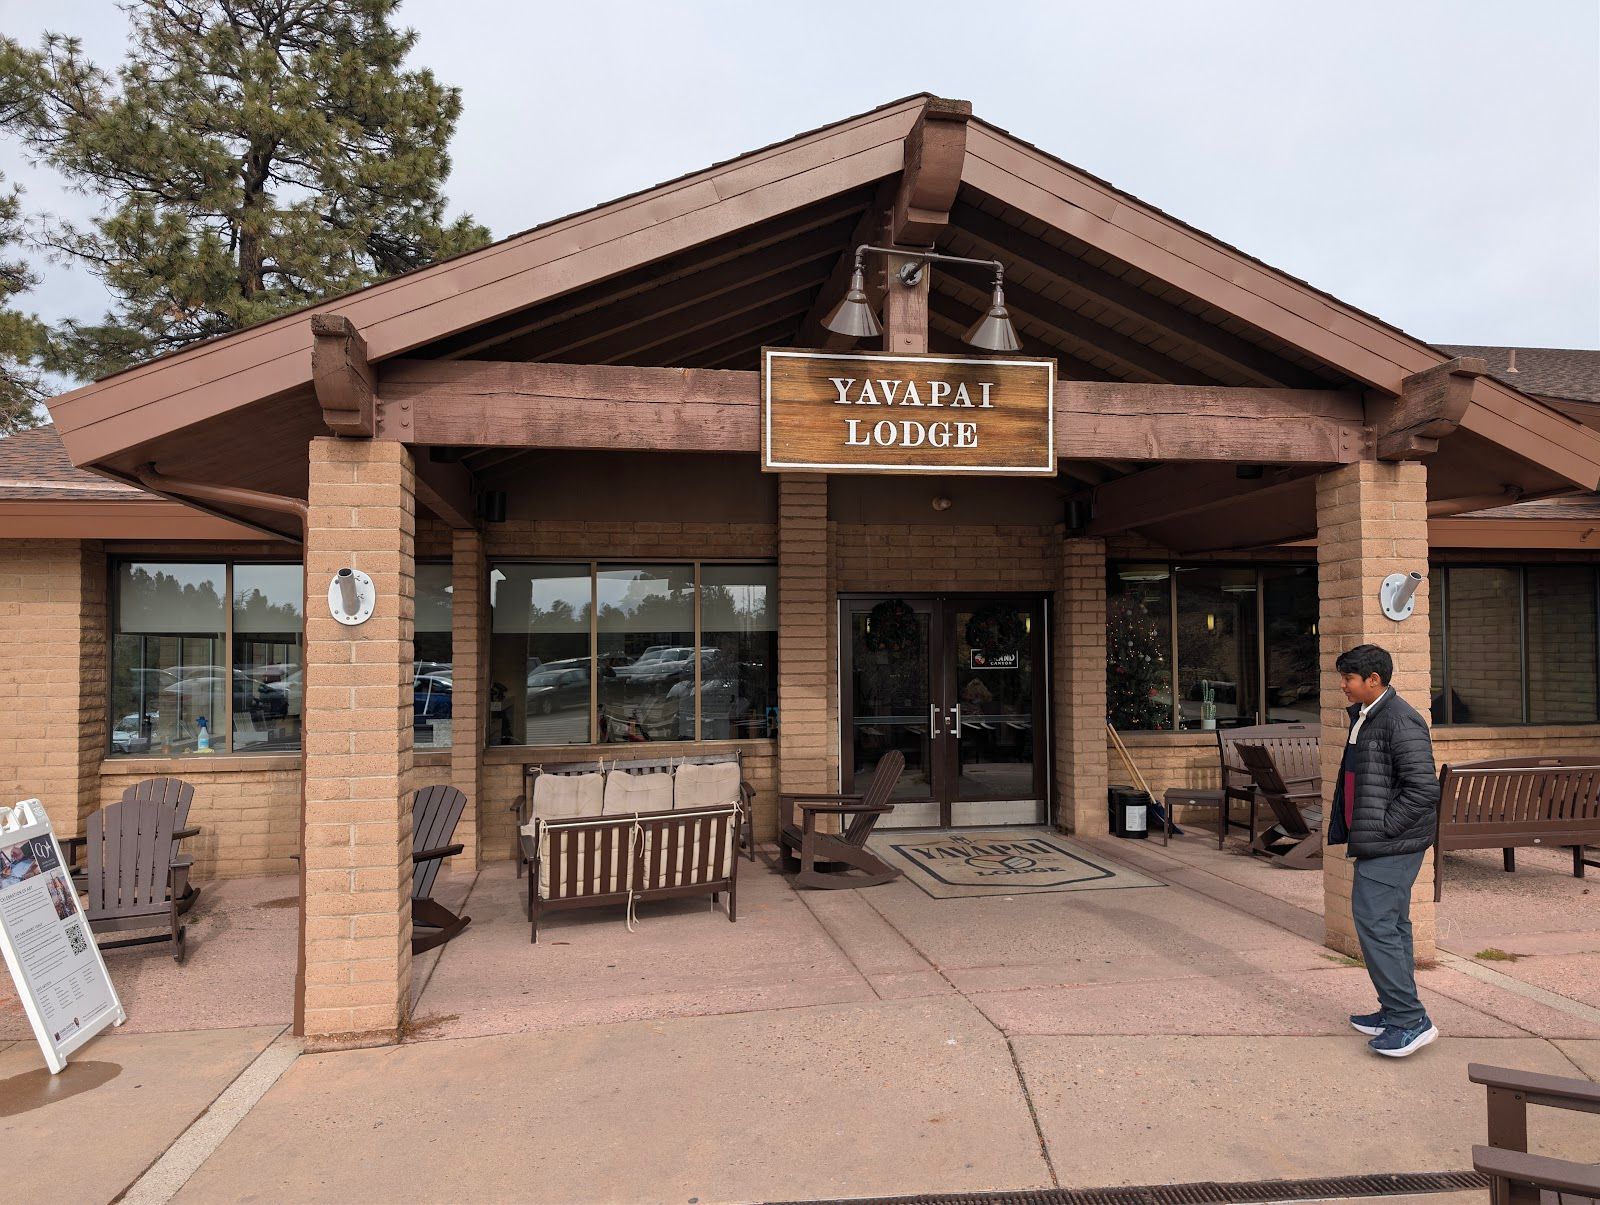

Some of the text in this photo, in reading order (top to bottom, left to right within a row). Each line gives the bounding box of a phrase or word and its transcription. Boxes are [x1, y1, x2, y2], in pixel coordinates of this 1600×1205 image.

[829, 377, 994, 407] YAVAPAI
[844, 419, 978, 448] LODGE
[912, 844, 1053, 859] YAVAPAI
[975, 866, 1066, 877] LODGE
